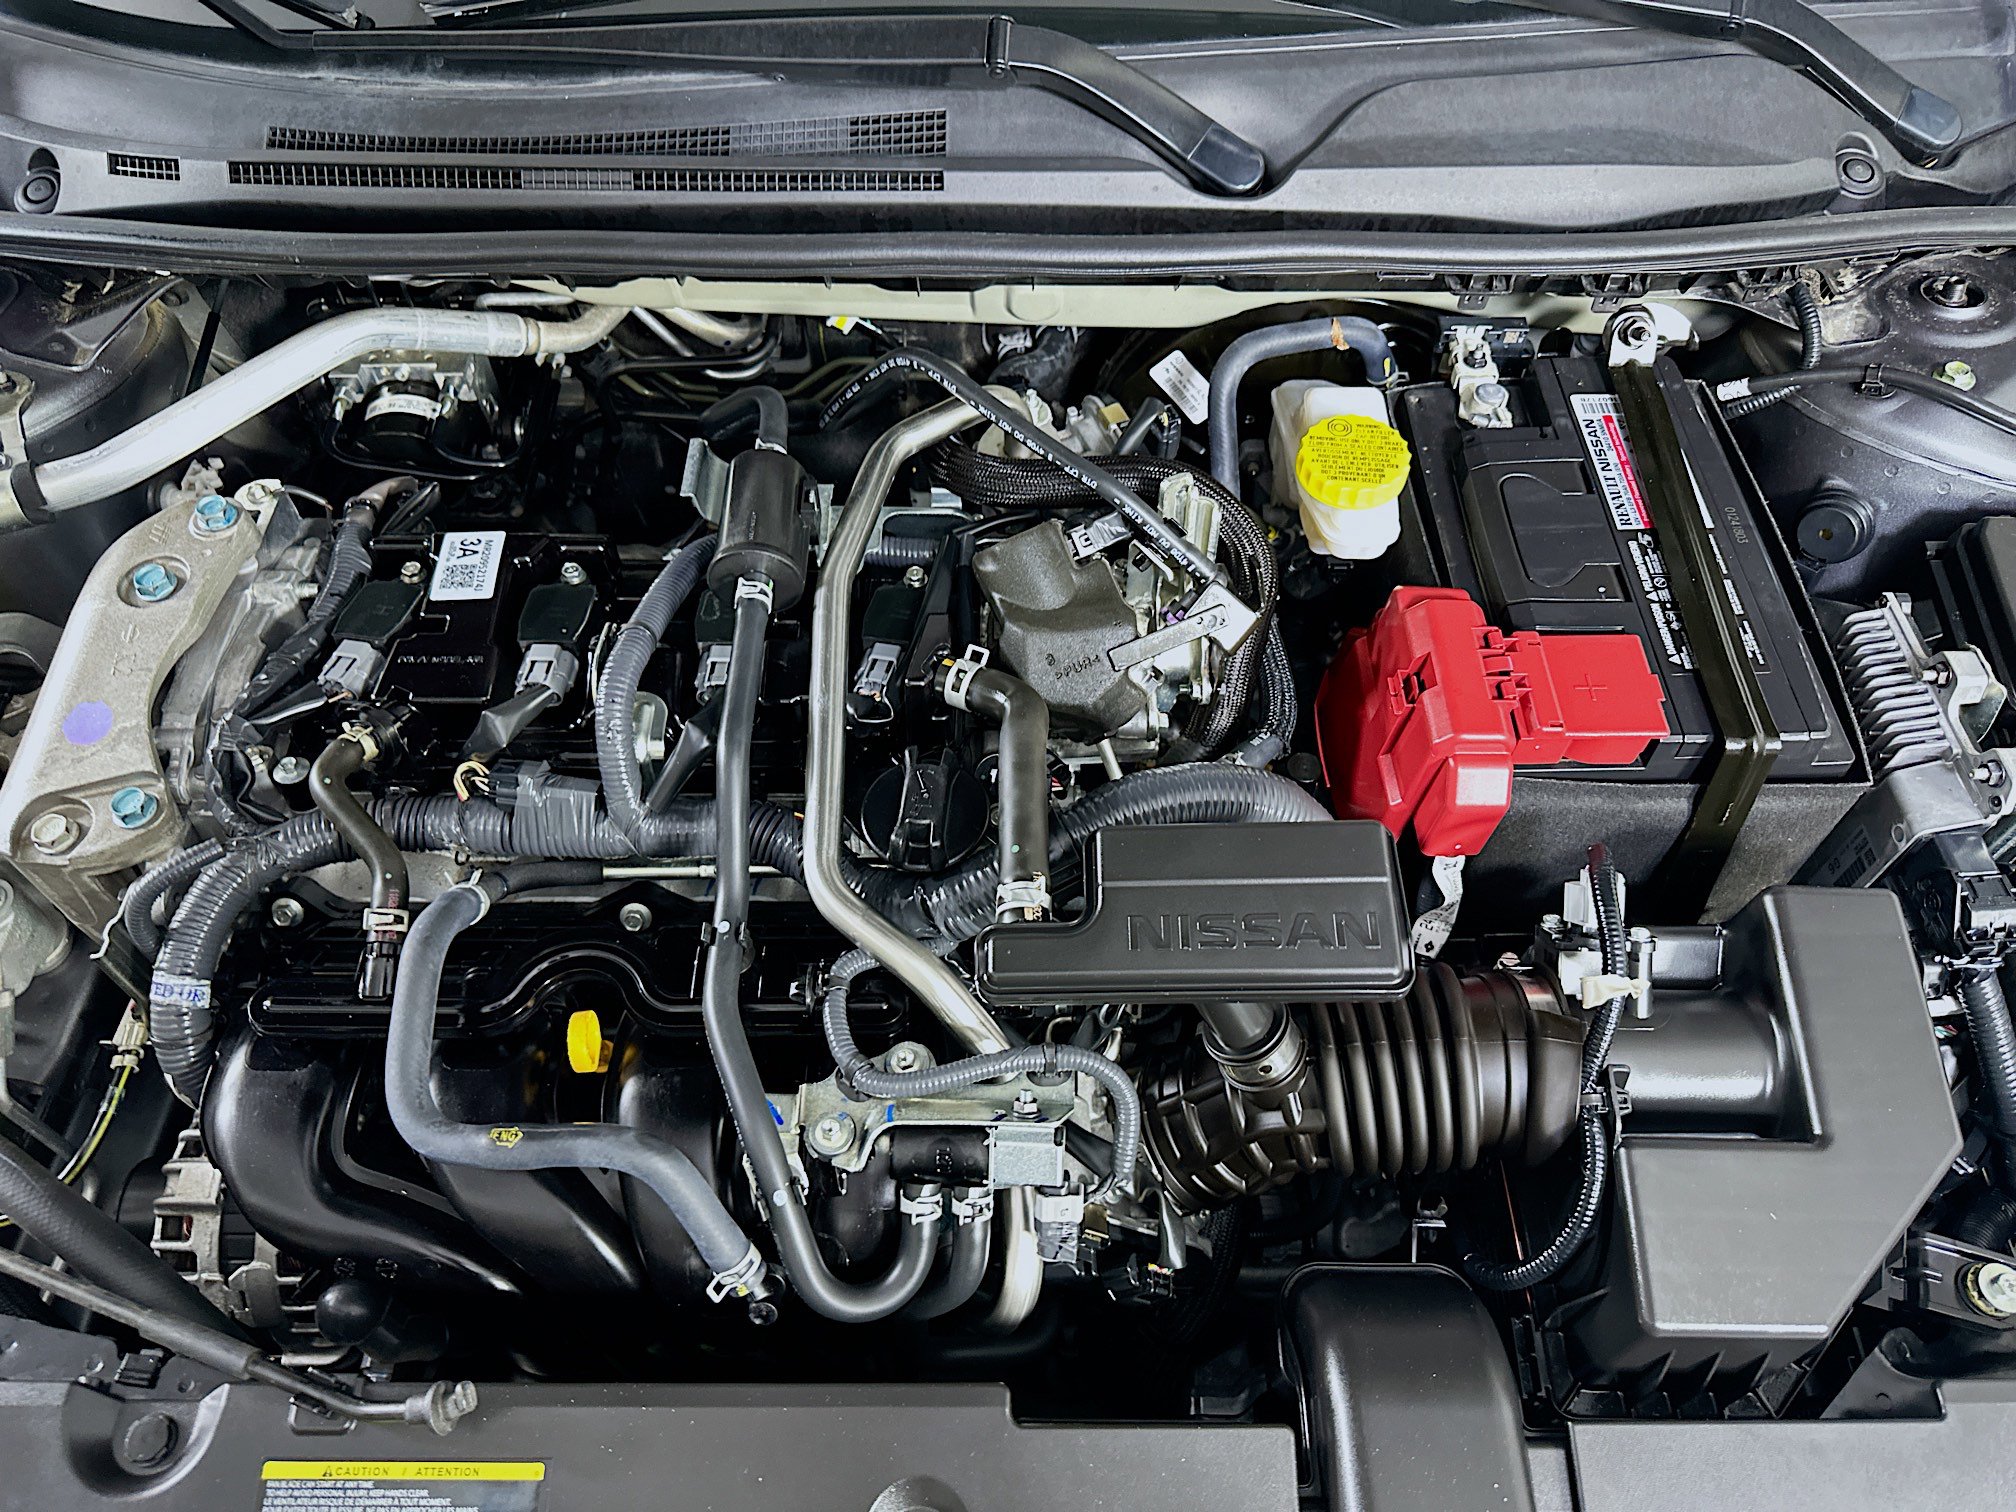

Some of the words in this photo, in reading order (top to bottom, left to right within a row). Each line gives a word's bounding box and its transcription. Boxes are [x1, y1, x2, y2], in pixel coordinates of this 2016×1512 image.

[1583, 419, 1612, 472] NISSAN
[1603, 475, 1633, 526] RENAULT
[456, 538, 482, 559] 3A
[1127, 912, 1382, 951] NISSAN
[335, 1467, 389, 1476] CAUTION
[415, 1467, 480, 1477] ATTENTION
